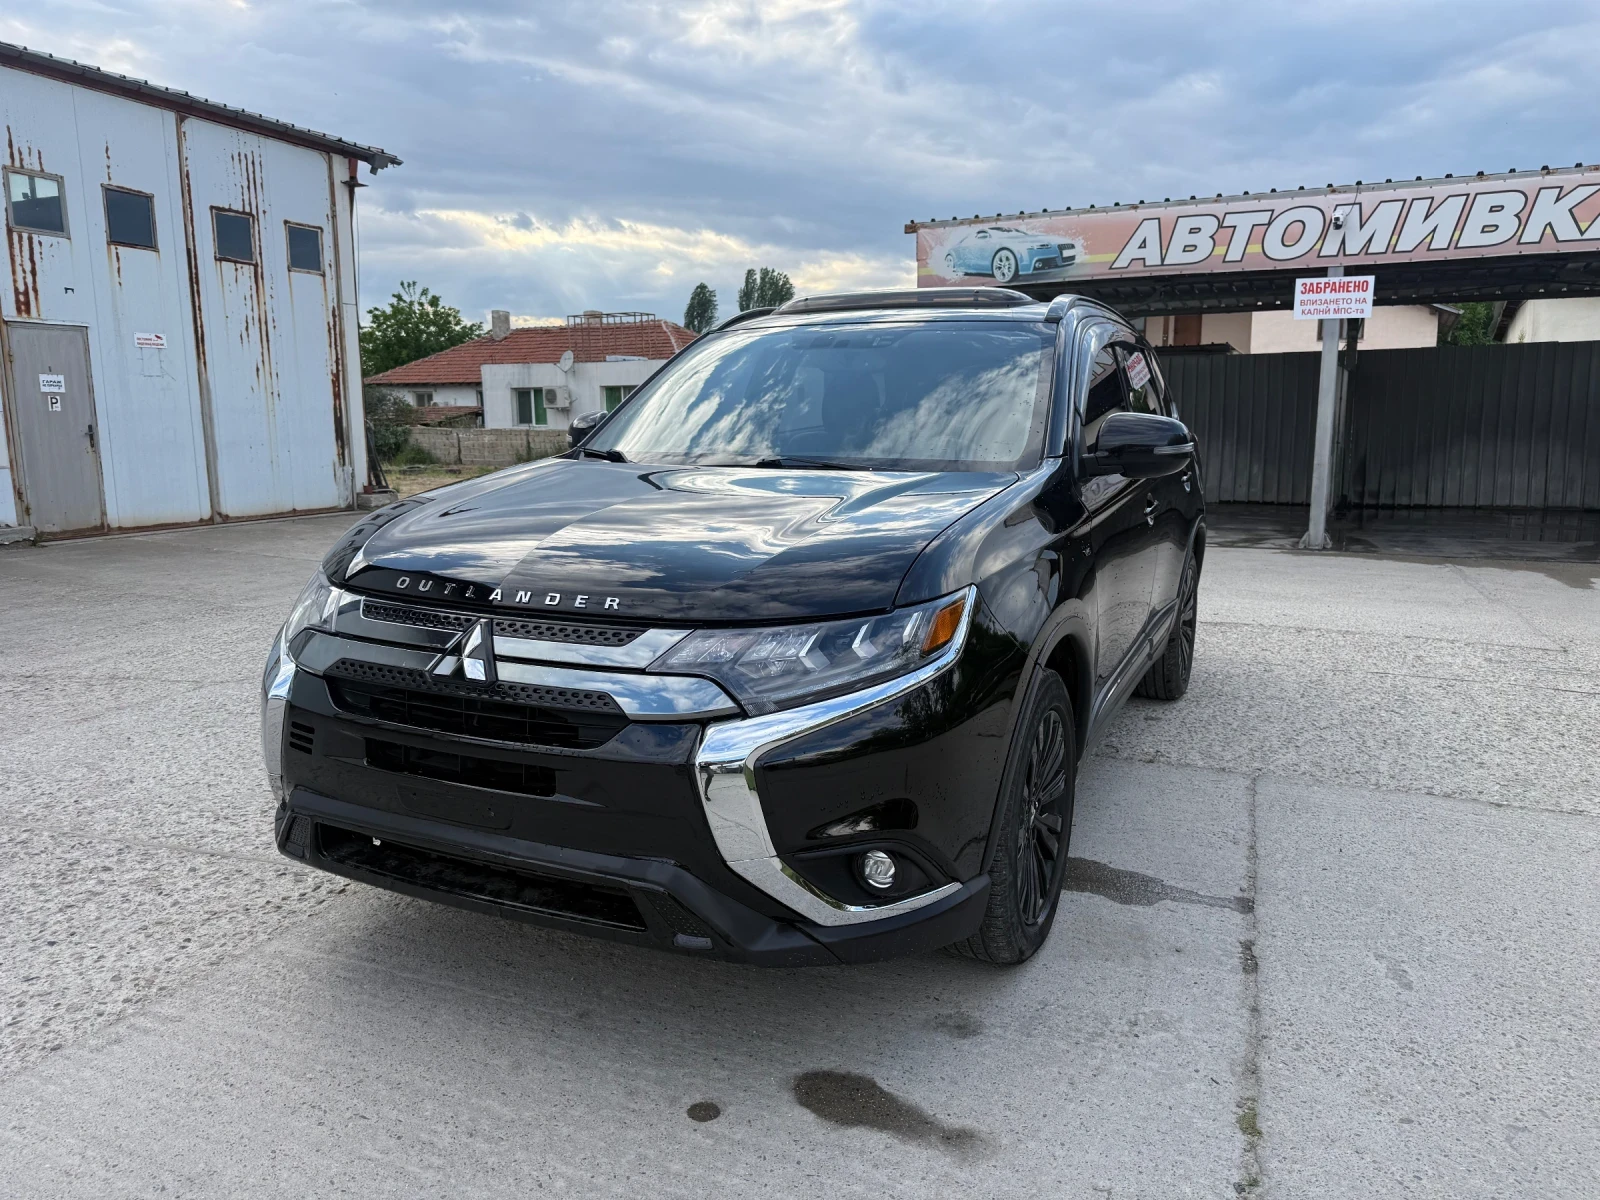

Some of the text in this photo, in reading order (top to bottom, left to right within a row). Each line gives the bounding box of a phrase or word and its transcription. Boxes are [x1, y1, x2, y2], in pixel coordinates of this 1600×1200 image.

[1300, 280, 1369, 295] ЗАБРАНЕНО
[1300, 298, 1352, 306] ВЛИЗАНЕТО
[396, 576, 620, 610] OUTLANDER
